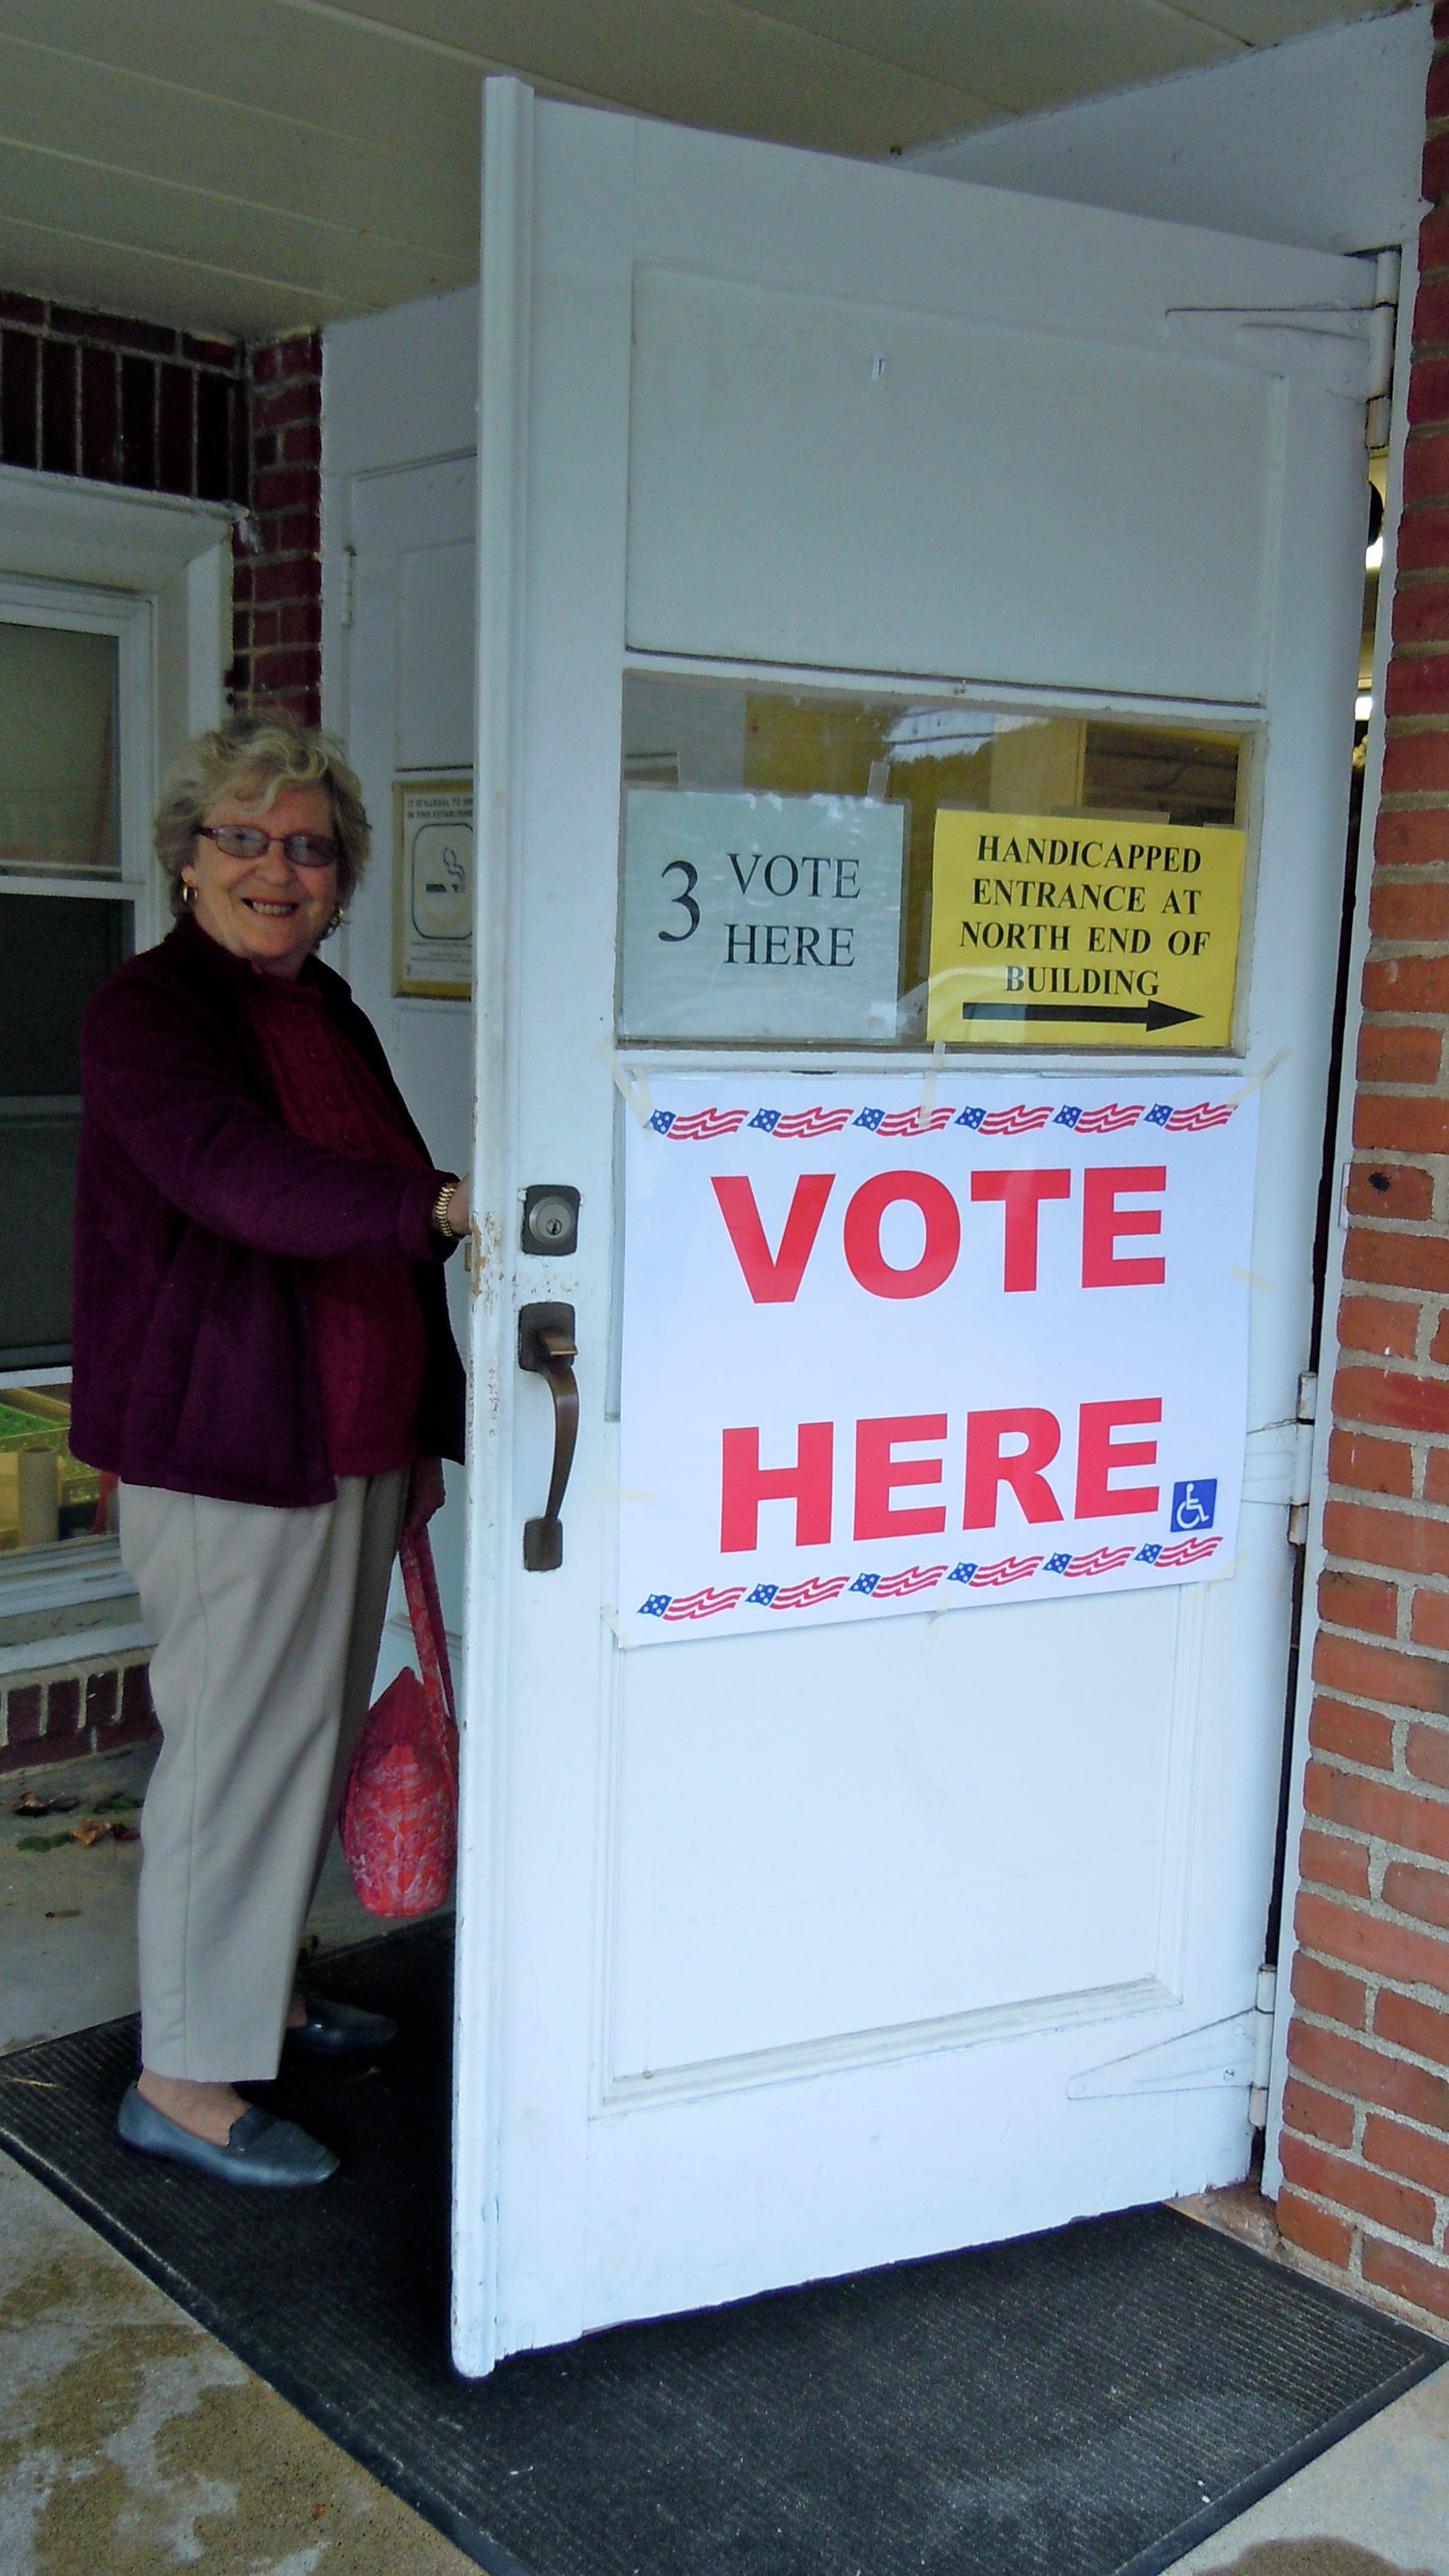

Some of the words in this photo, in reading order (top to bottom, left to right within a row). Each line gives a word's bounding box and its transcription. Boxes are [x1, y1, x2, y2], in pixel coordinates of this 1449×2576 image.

[726, 853, 861, 900] VOTE
[976, 834, 1201, 874] HANDICAPPED
[657, 860, 701, 942] 3
[972, 878, 1146, 913] ENTRANCE
[1161, 888, 1202, 915] AT
[723, 923, 856, 968] HERE
[959, 921, 1070, 951] NORTH
[1087, 926, 1151, 954] END
[1167, 930, 1211, 956] OF
[1005, 965, 1159, 996] BUILDING
[710, 1165, 1167, 1304] VOTE
[720, 1397, 1162, 1554] HERE
